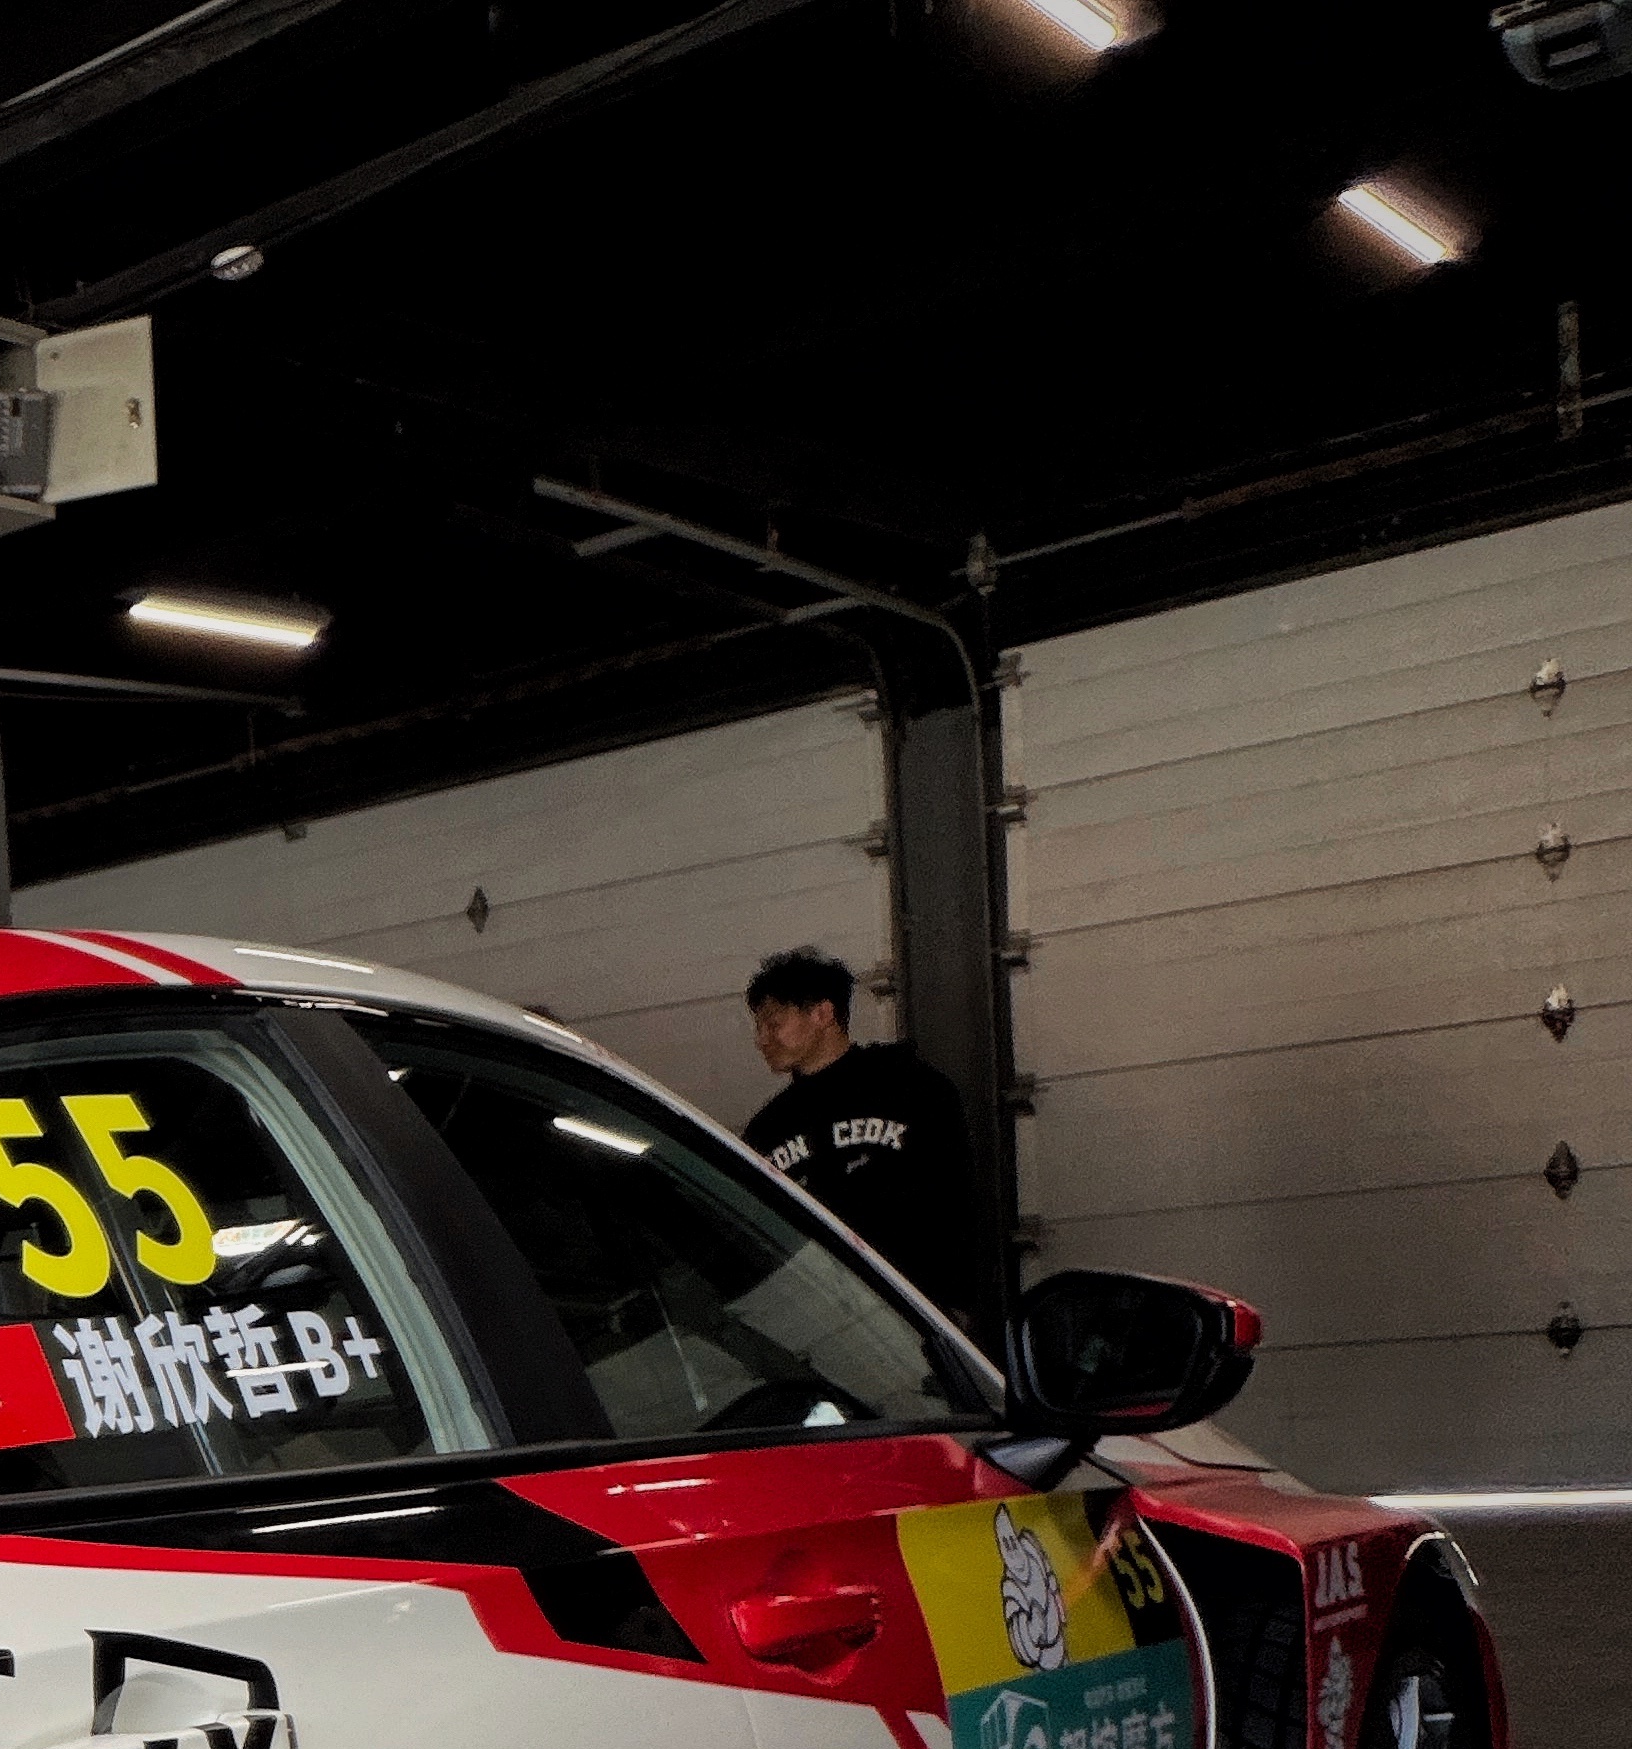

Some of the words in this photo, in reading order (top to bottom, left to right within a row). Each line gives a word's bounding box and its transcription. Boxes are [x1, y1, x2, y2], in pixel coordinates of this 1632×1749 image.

[52, 1303, 298, 1438] 谢欣哲
[287, 1310, 383, 1397] B+
